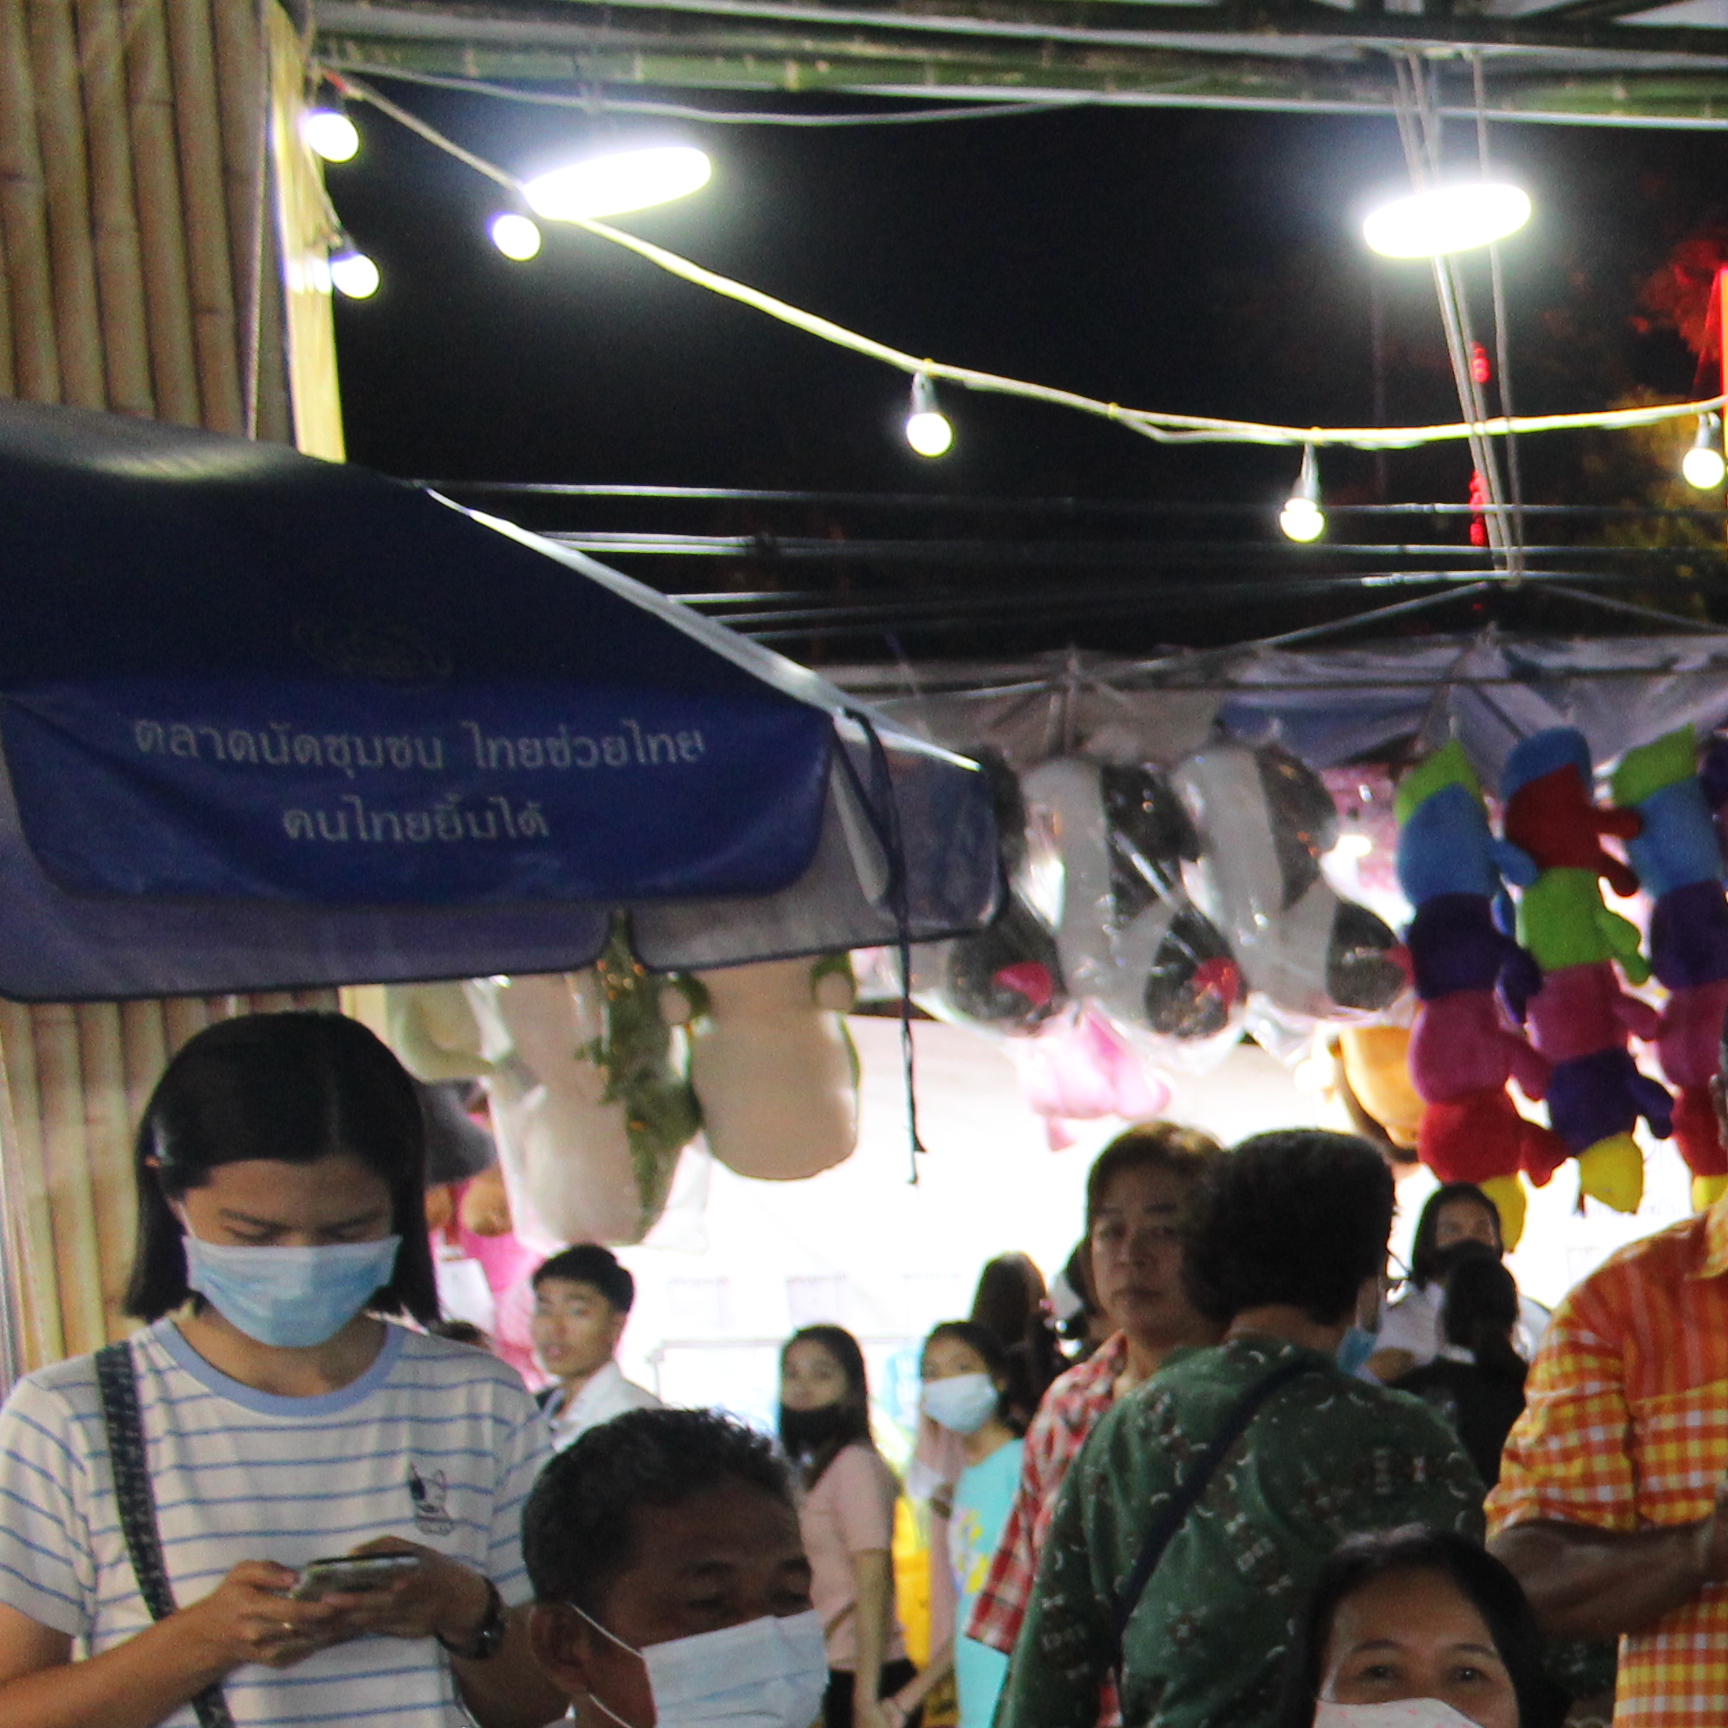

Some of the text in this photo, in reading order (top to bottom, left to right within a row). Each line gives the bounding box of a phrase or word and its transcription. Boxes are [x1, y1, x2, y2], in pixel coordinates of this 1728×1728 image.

[132, 719, 706, 779] ตลาดนัดชุมชน ไทยช่วยไทย
[281, 793, 550, 843] คนไทยยิ้มได้
